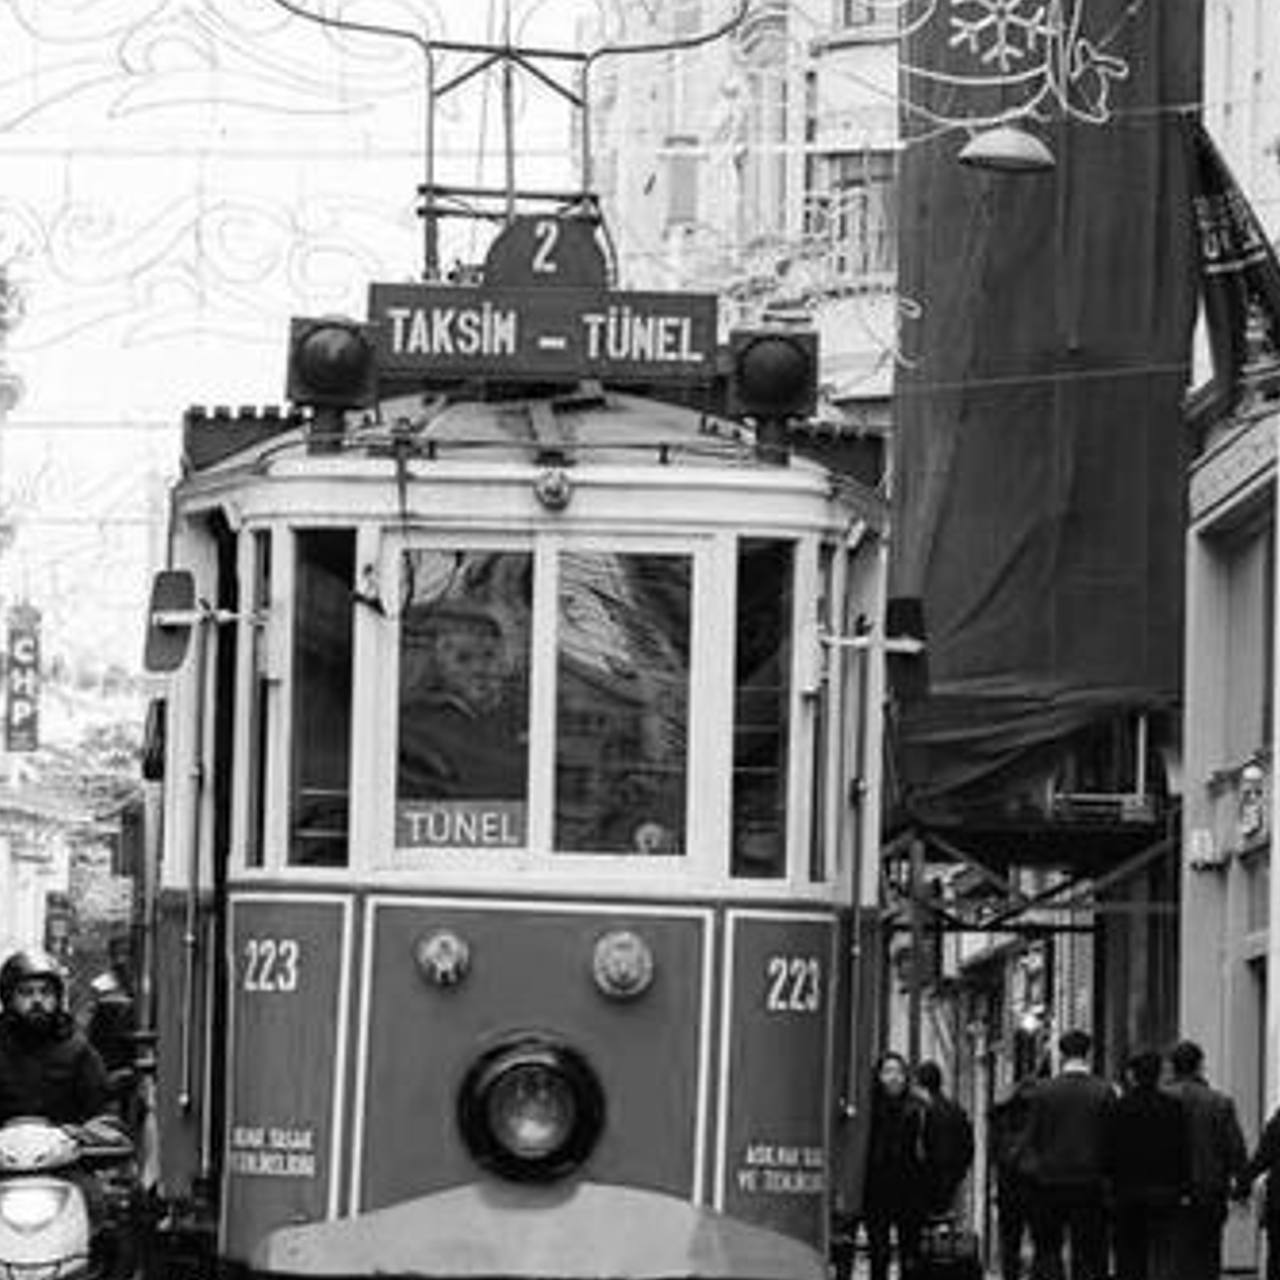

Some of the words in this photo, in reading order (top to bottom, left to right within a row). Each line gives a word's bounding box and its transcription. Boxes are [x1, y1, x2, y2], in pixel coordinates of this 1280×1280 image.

[533, 219, 557, 272] 2
[387, 302, 515, 354] TAKSİM
[583, 307, 704, 361] TÜNEL
[244, 939, 298, 991] 223
[767, 956, 819, 1011] 223
